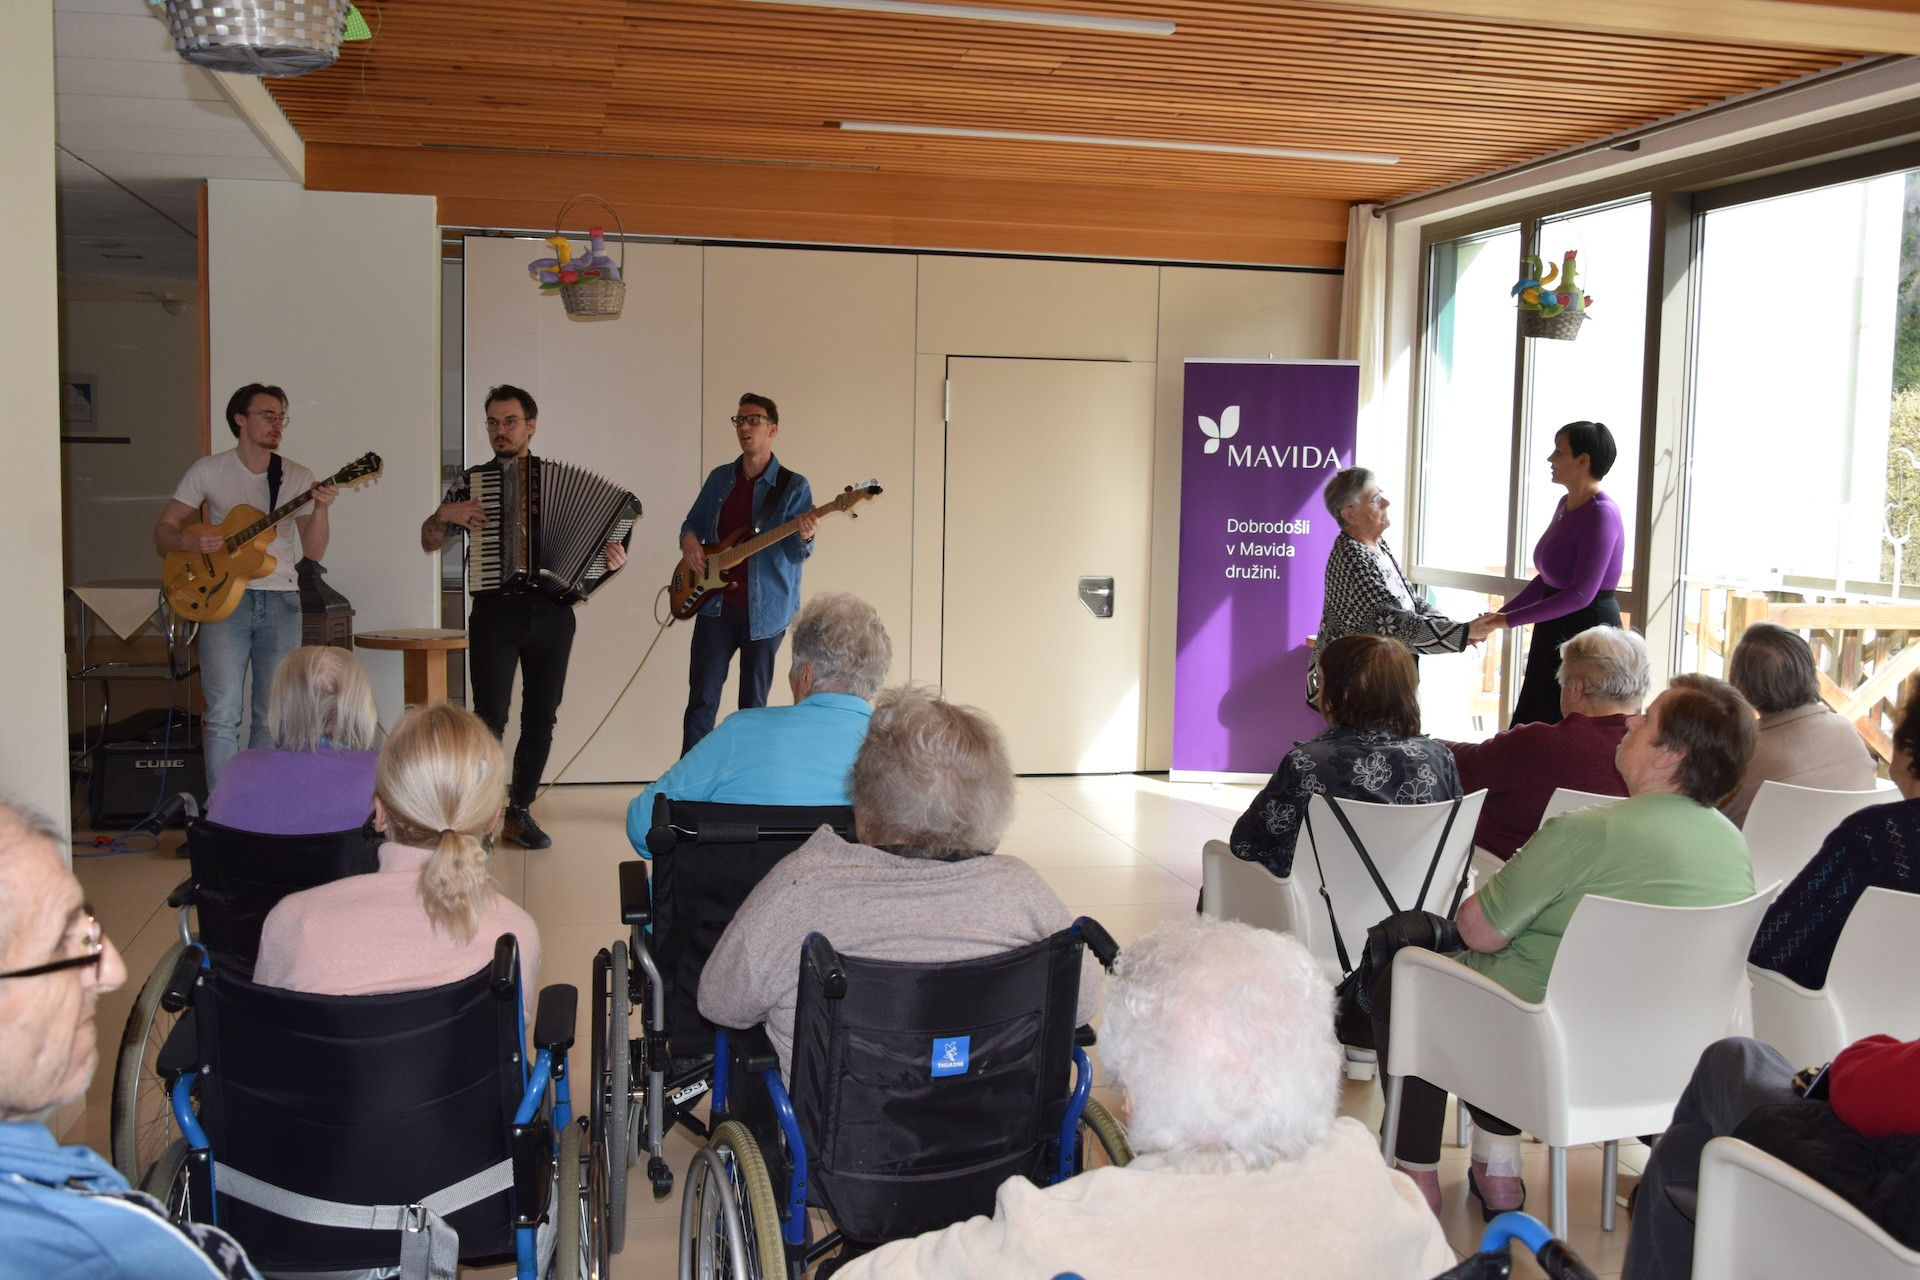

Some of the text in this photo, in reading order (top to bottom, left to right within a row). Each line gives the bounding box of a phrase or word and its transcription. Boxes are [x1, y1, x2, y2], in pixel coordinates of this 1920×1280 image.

[1228, 445, 1342, 469] MAVIDA
[1227, 518, 1311, 535] Dobrodošli
[1226, 542, 1296, 557] v Mavida
[1225, 564, 1281, 579] družini.
[135, 760, 185, 768] CUBE
[937, 1061, 964, 1069] THUASNE
